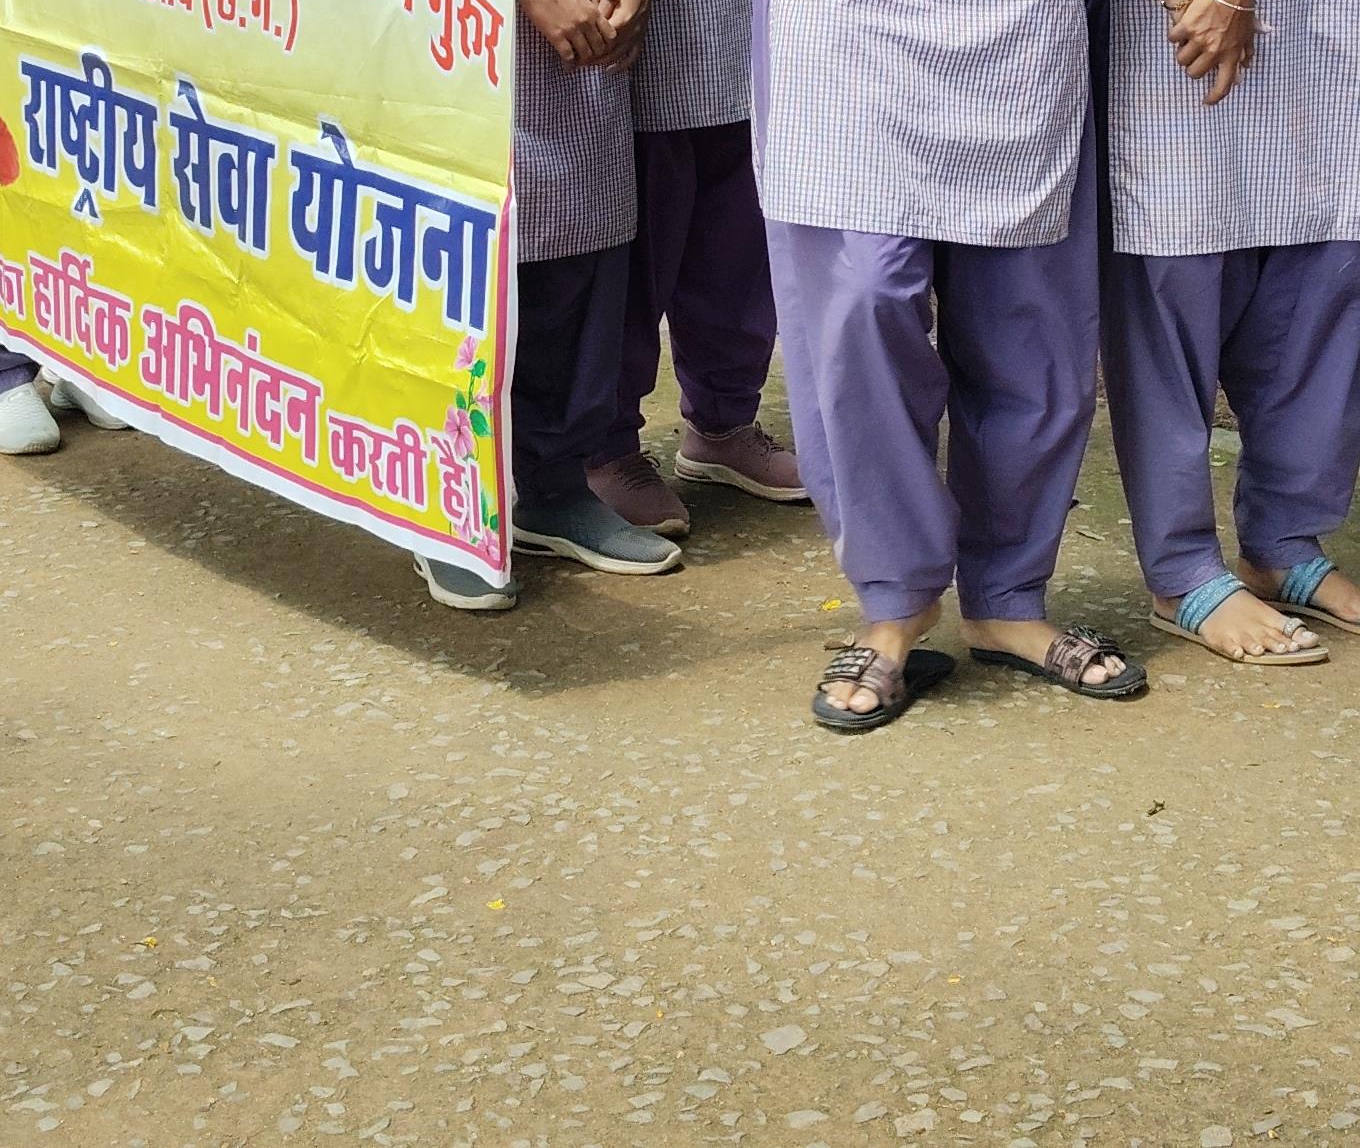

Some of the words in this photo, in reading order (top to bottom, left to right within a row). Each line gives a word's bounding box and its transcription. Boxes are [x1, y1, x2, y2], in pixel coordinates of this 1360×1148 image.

[21, 53, 157, 219] राष्ट्रीय
[170, 79, 275, 251] सेवा
[291, 122, 496, 331] योजना
[29, 251, 131, 367] हार्दिक
[141, 304, 321, 463] अभिनंदन
[328, 423, 426, 507] करती
